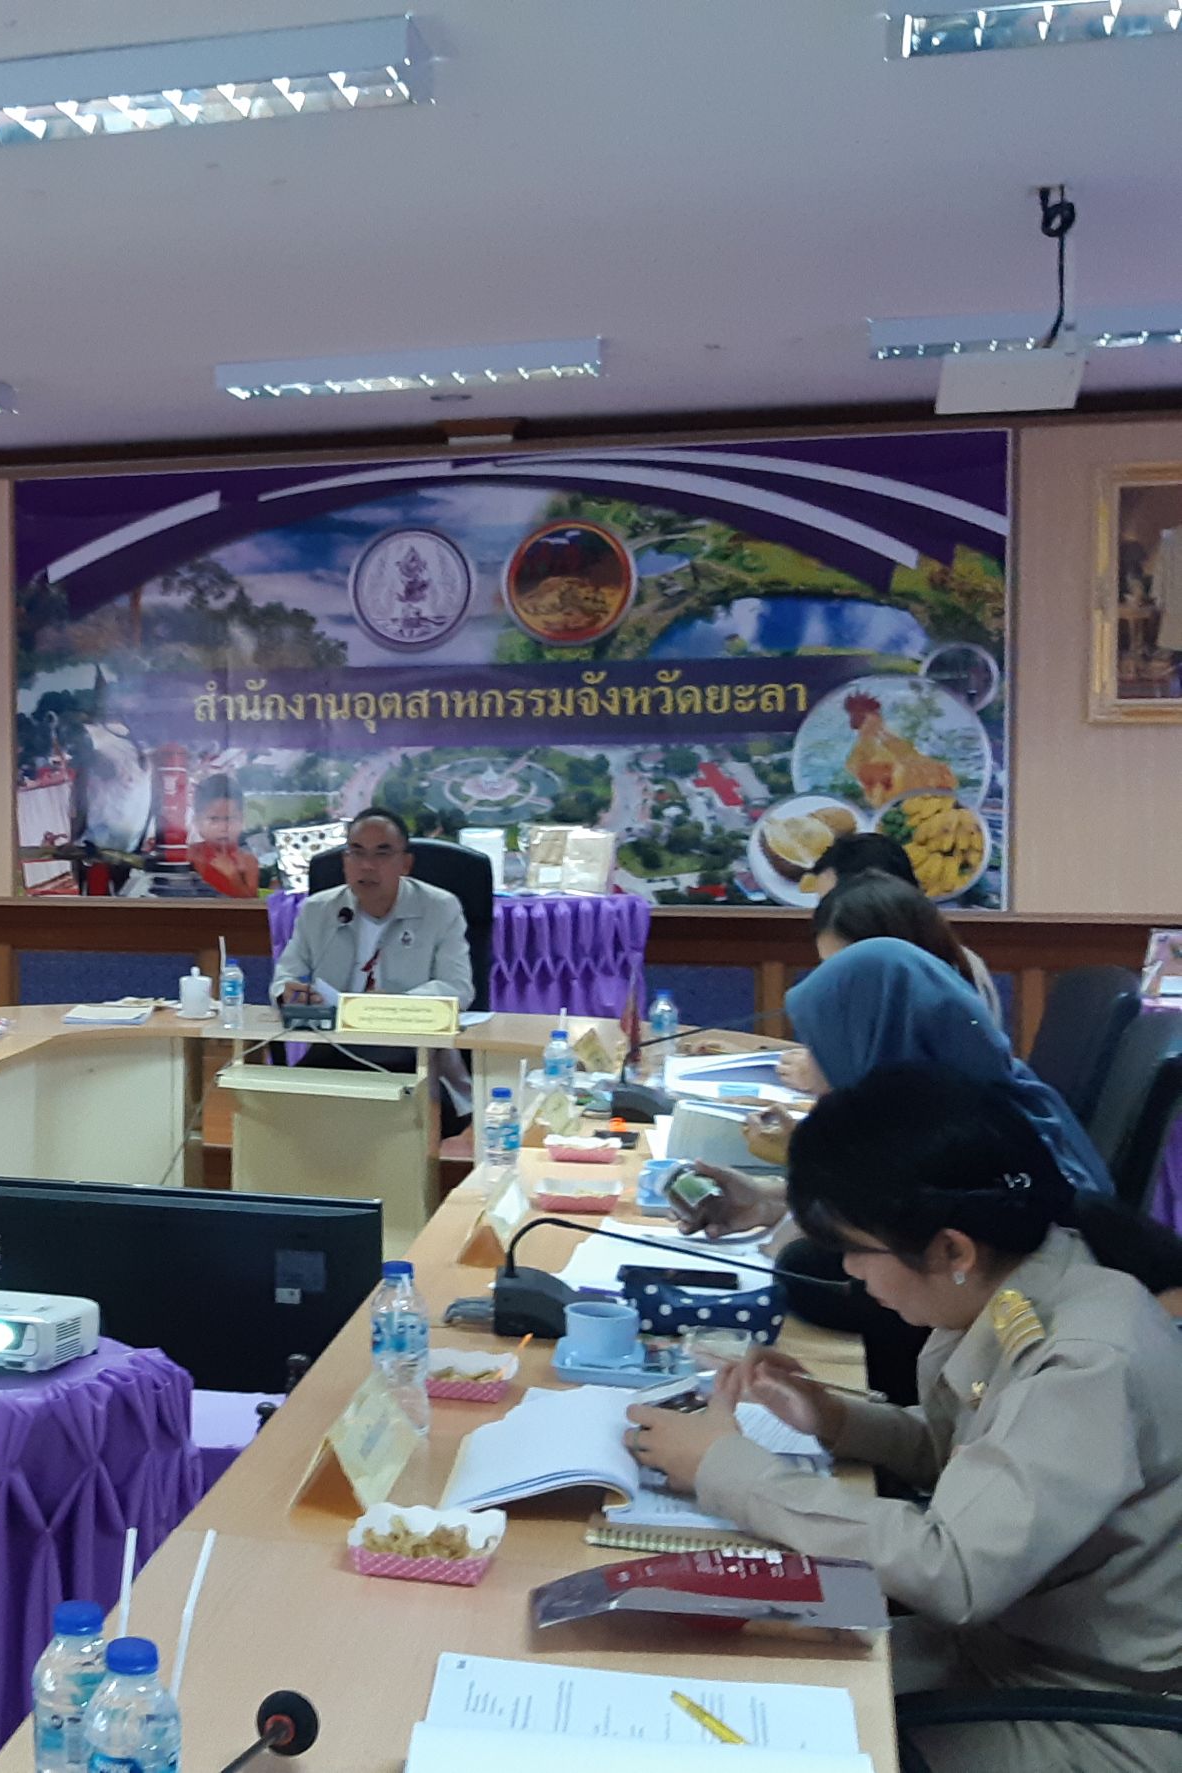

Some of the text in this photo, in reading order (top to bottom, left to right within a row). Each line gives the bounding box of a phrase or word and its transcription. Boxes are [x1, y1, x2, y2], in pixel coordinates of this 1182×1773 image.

[193, 669, 809, 734] สำนักงานอุตสาหกรรมจังหวัดยะลา
